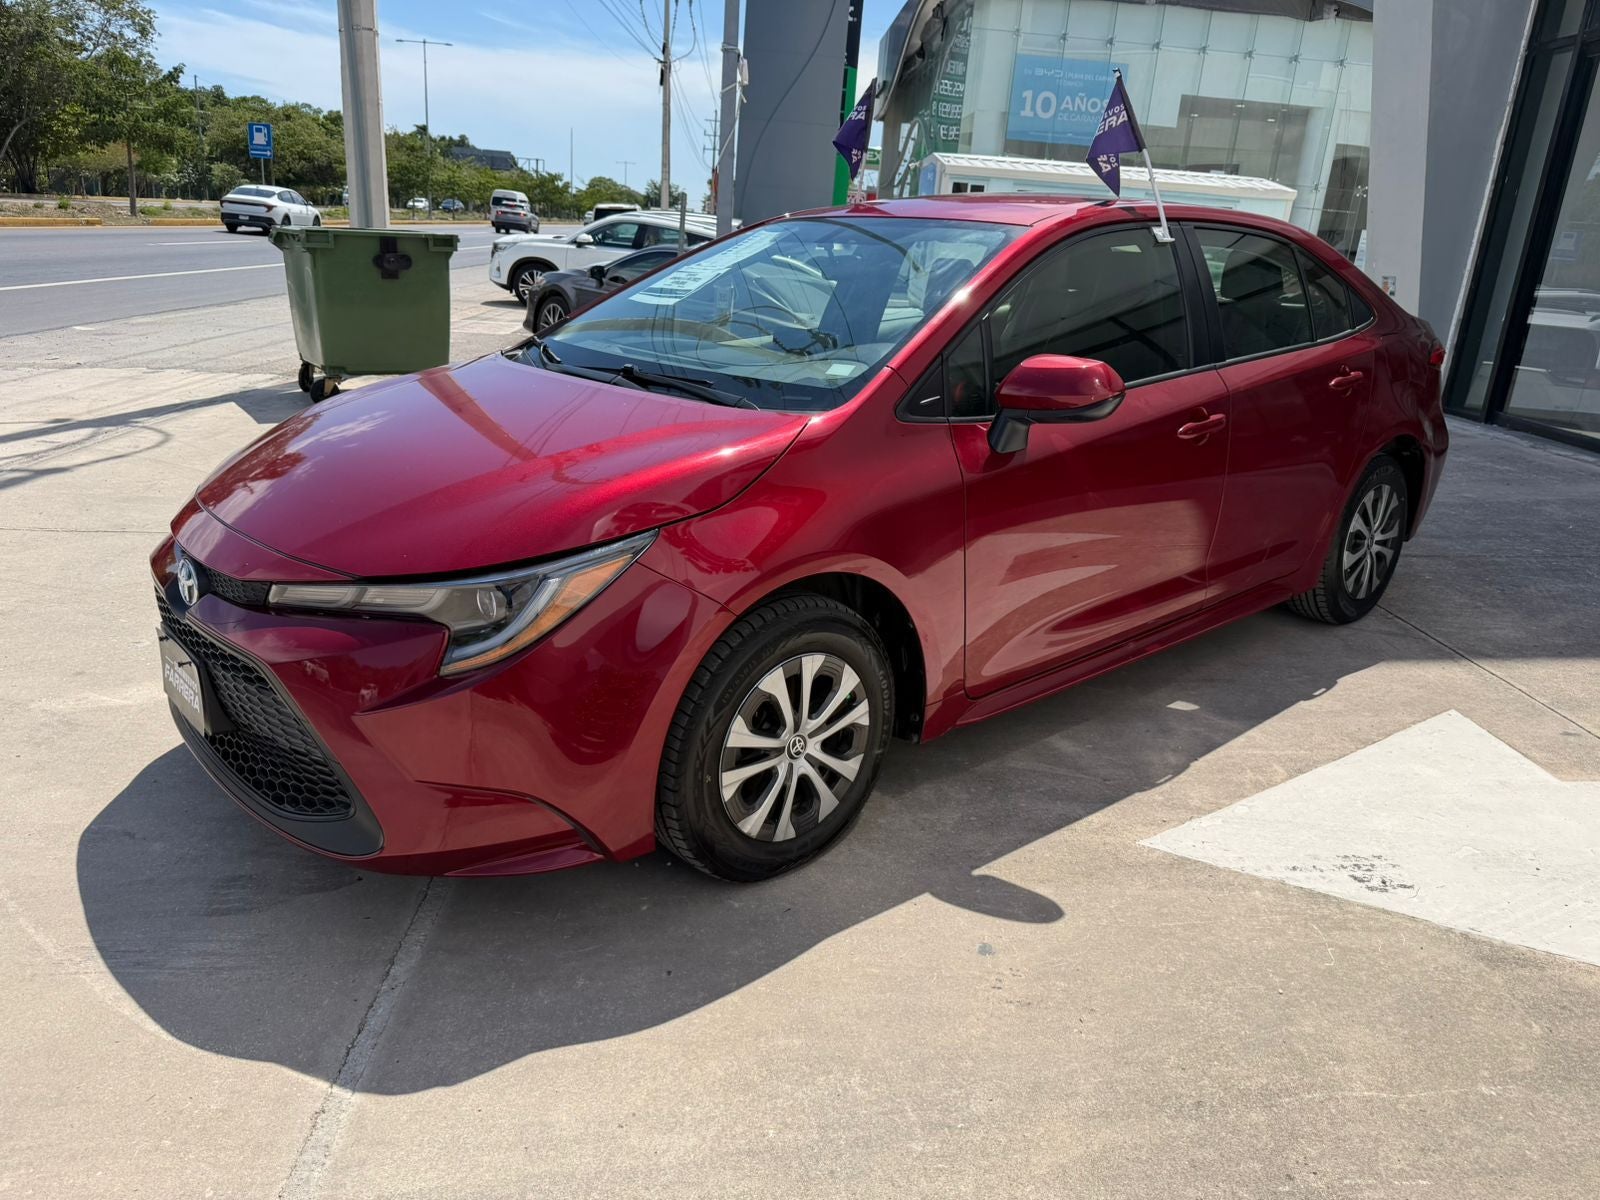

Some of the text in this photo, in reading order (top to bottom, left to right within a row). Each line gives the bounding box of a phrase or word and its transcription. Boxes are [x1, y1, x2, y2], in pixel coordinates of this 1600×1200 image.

[1034, 68, 1063, 77] BYD
[1020, 90, 1057, 119] 10
[1096, 110, 1129, 135] ERA
[165, 663, 200, 712] FARRERA
